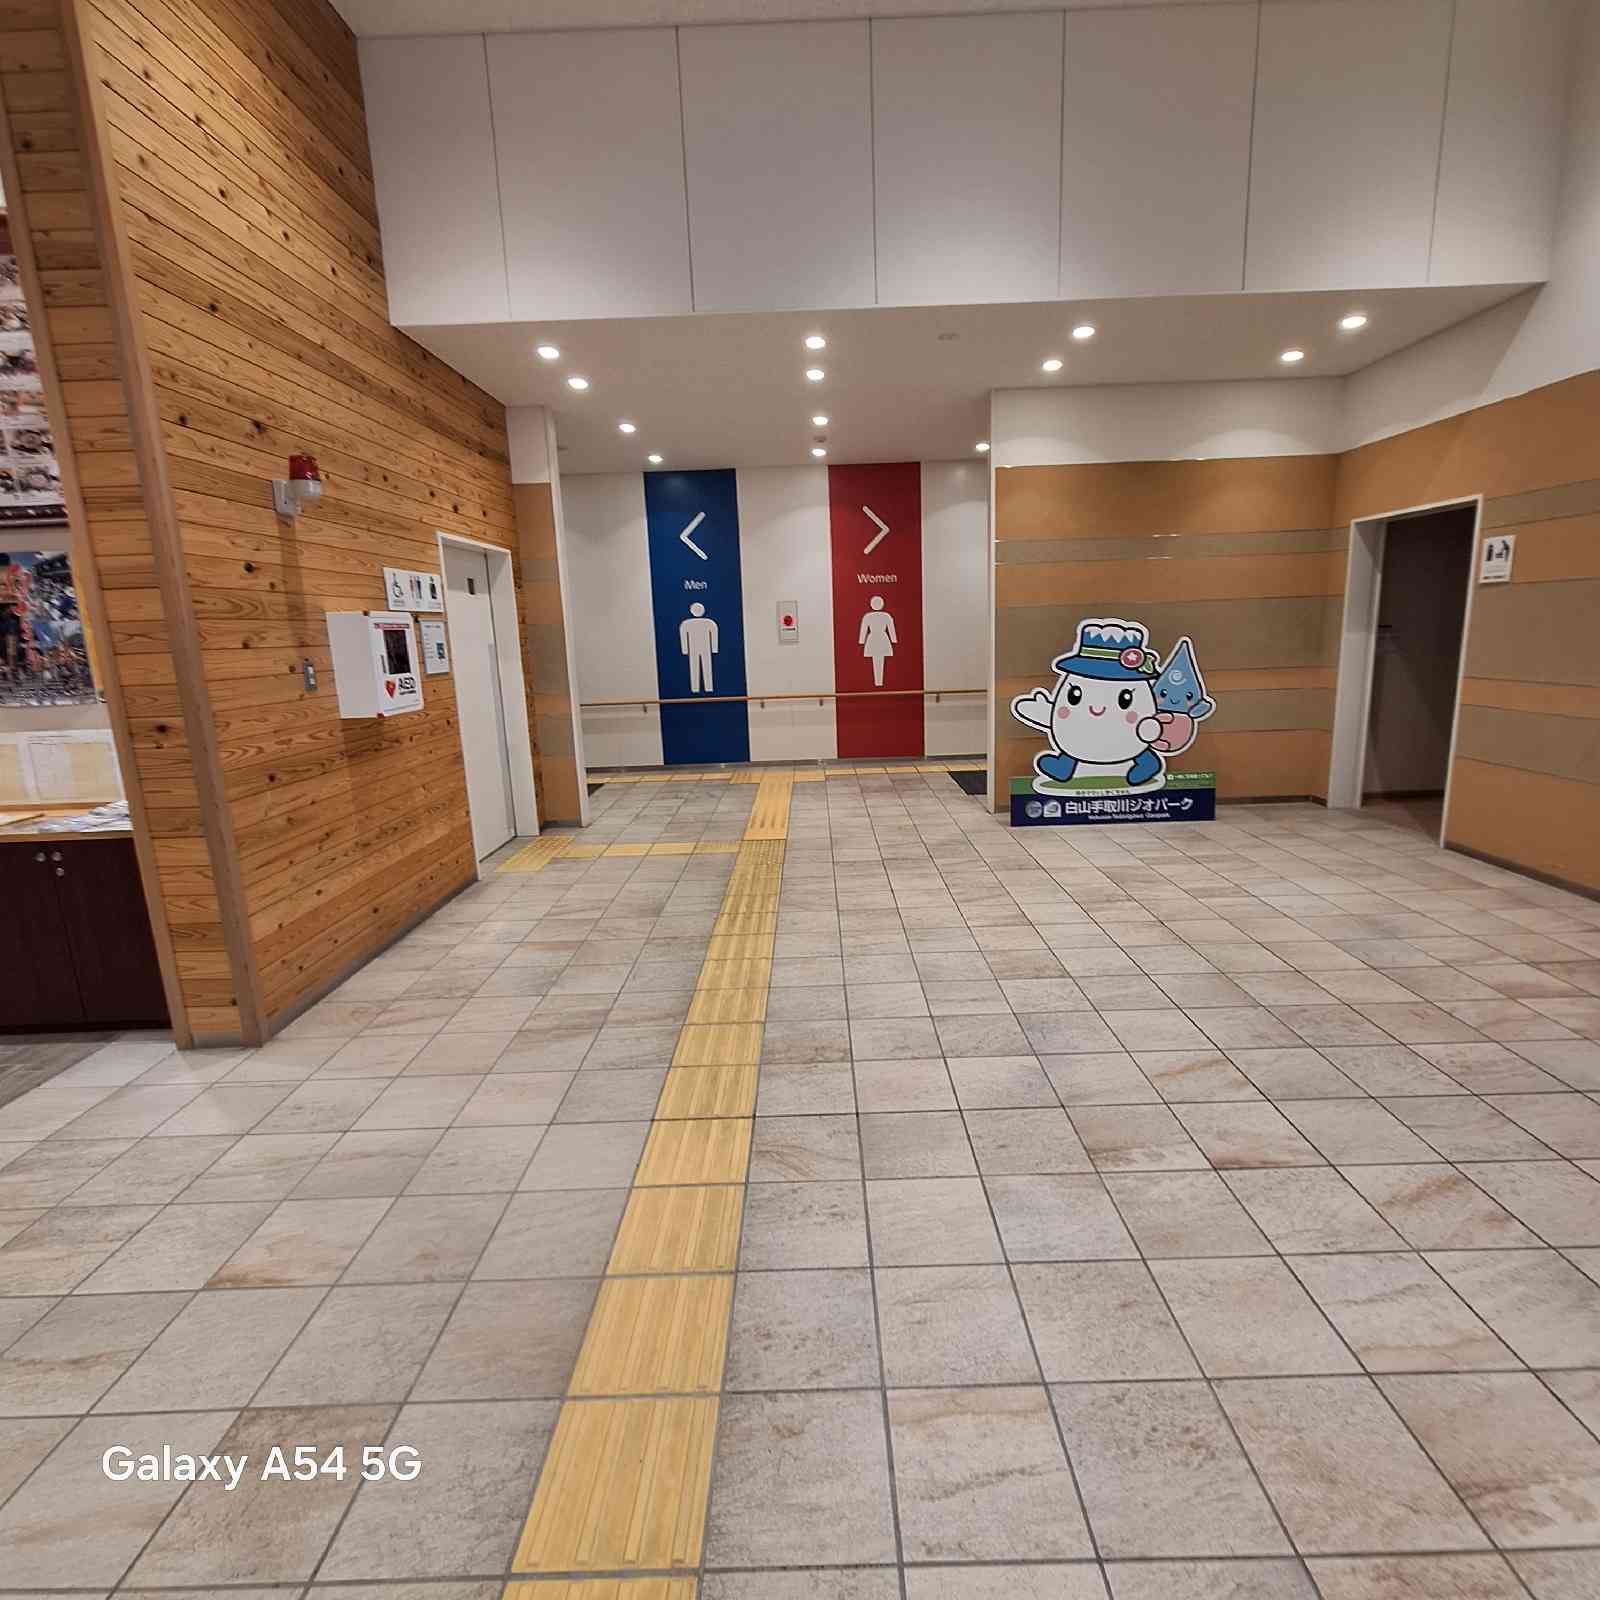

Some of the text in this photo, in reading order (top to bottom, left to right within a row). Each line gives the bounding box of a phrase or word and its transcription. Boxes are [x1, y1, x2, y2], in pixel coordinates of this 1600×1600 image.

[857, 573, 898, 584] Women
[684, 579, 708, 590] Men
[1065, 798, 1193, 814] 白山手取川ジオパーク
